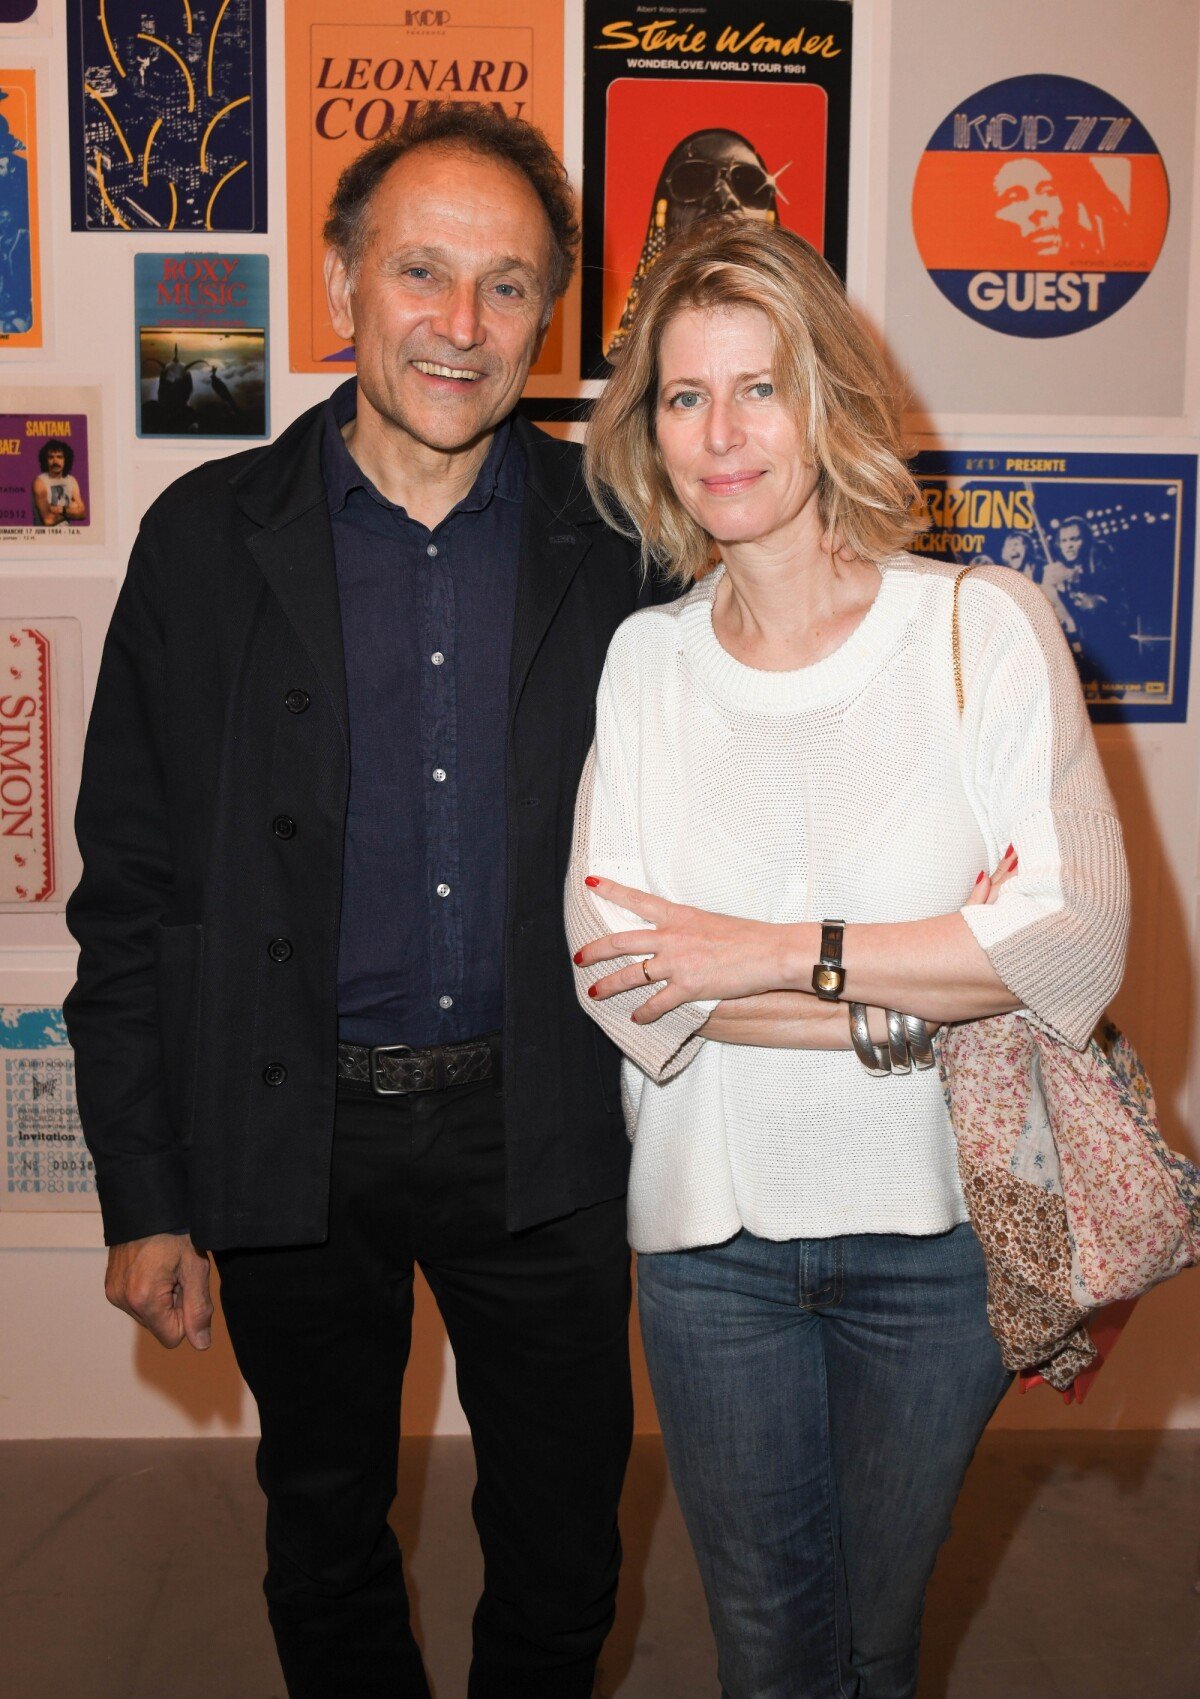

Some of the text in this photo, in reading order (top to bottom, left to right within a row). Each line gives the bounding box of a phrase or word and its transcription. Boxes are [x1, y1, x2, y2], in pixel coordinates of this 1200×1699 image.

[405, 9, 451, 27] KCP
[594, 21, 842, 58] Stevie Wonder
[315, 57, 529, 92] LEONARD
[752, 62, 781, 73] TOUR
[783, 65, 806, 75] 1981
[953, 113, 1132, 150] KCP 77
[163, 258, 239, 282] ROXY
[157, 281, 248, 307] MUSIC
[968, 271, 1106, 312] GUEST
[26, 420, 71, 437] SANTANA
[1006, 458, 1066, 471] PRESENTE
[0, 695, 36, 839] SIMON
[19, 1130, 76, 1141] Invitation
